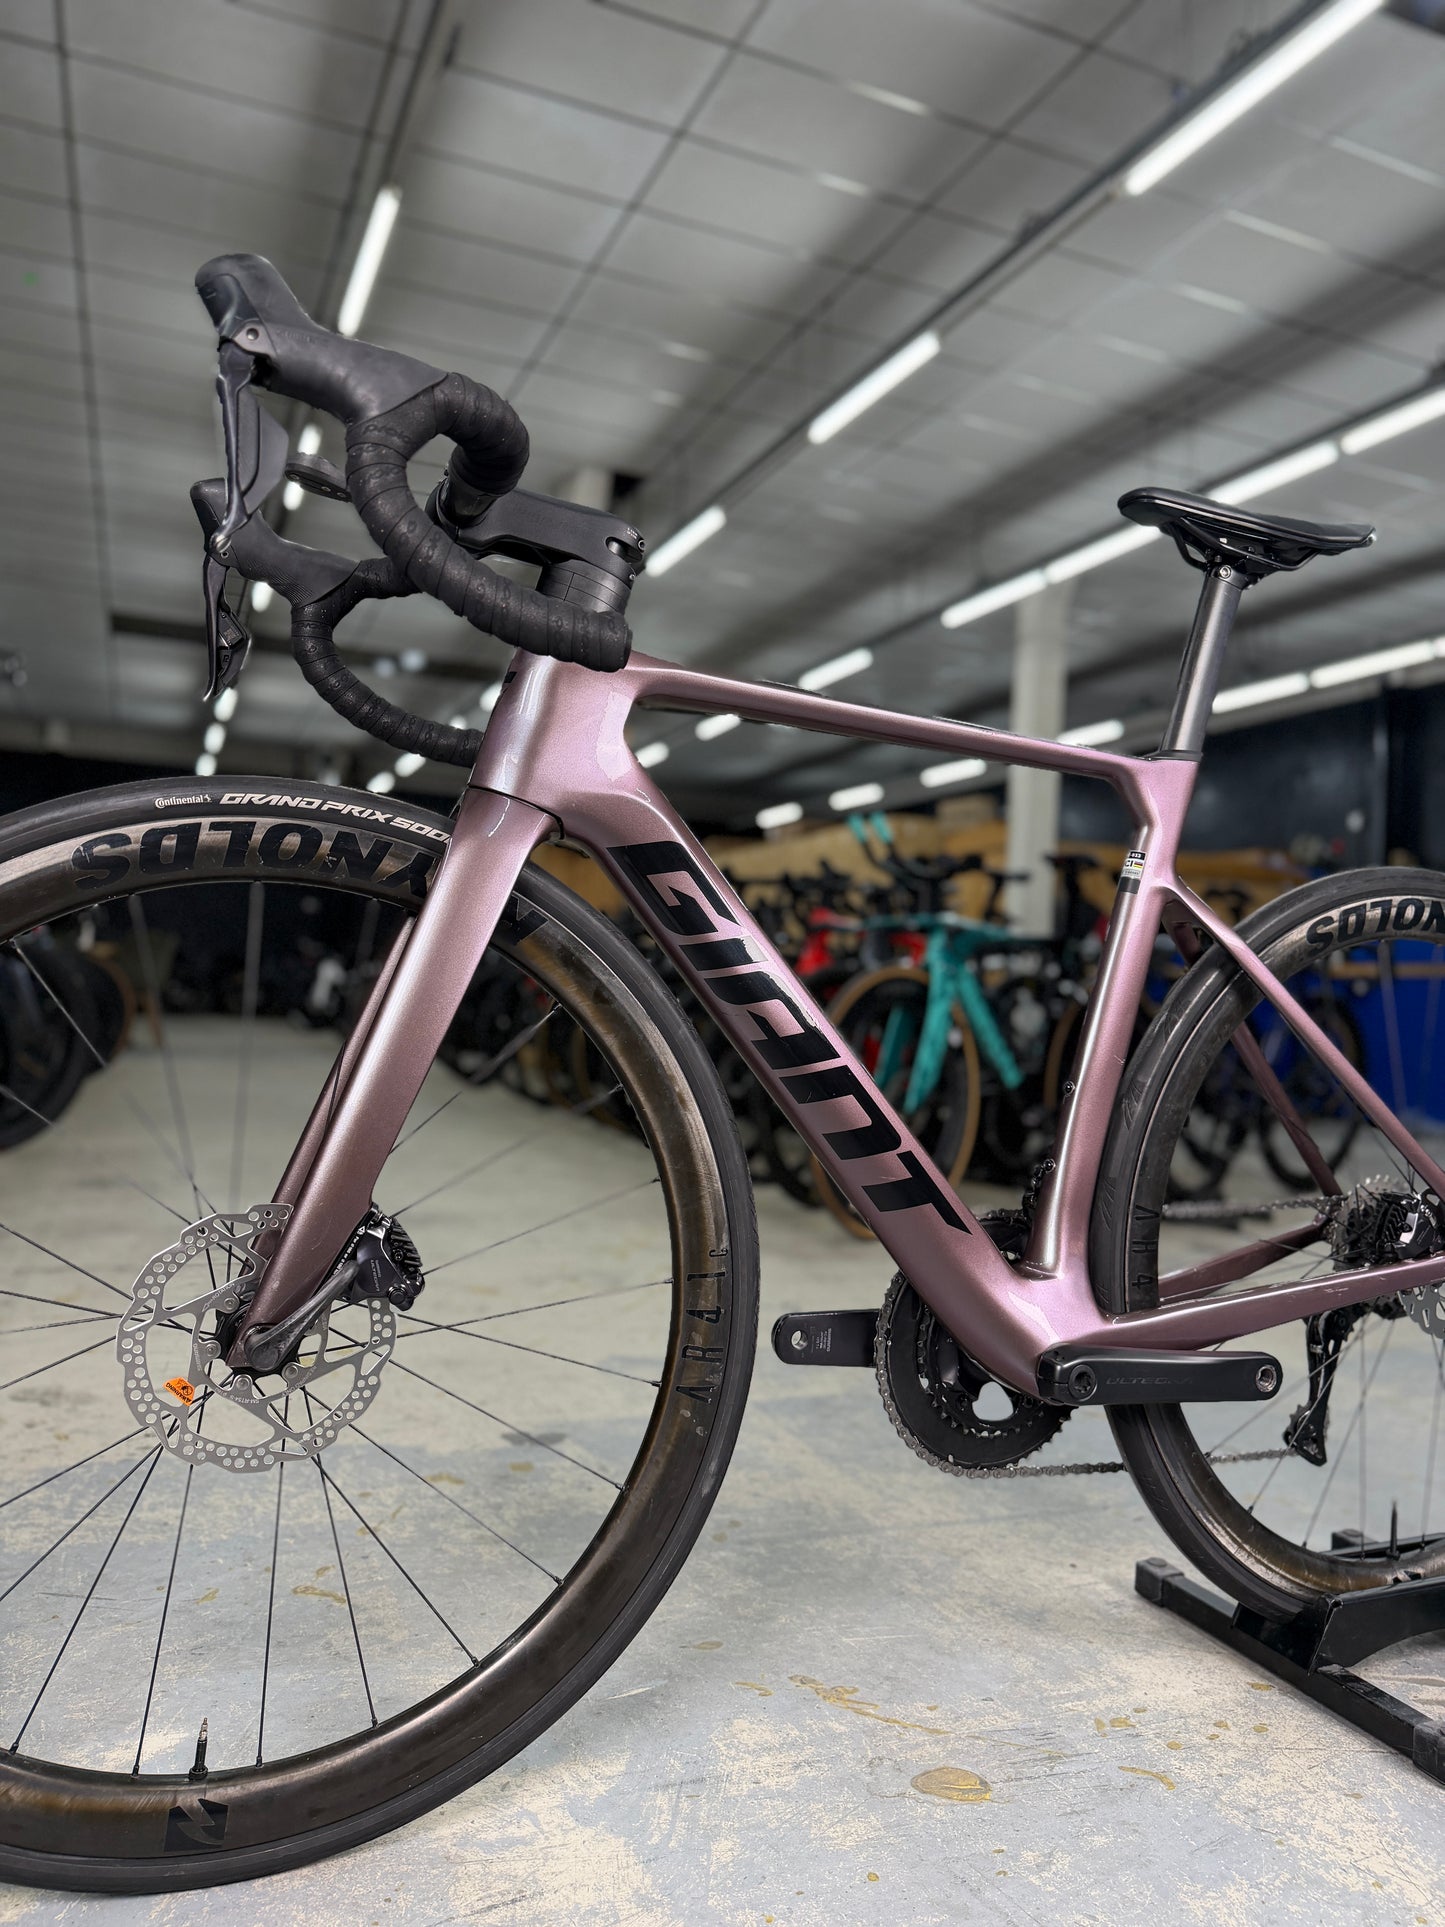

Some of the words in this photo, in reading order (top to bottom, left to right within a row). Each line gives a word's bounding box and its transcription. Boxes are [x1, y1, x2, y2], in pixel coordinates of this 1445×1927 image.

[154, 794, 203, 808] Continental
[219, 793, 323, 809] GRAND
[320, 800, 393, 823] PRIX
[389, 816, 450, 844] 500
[607, 841, 972, 1235] GIANT
